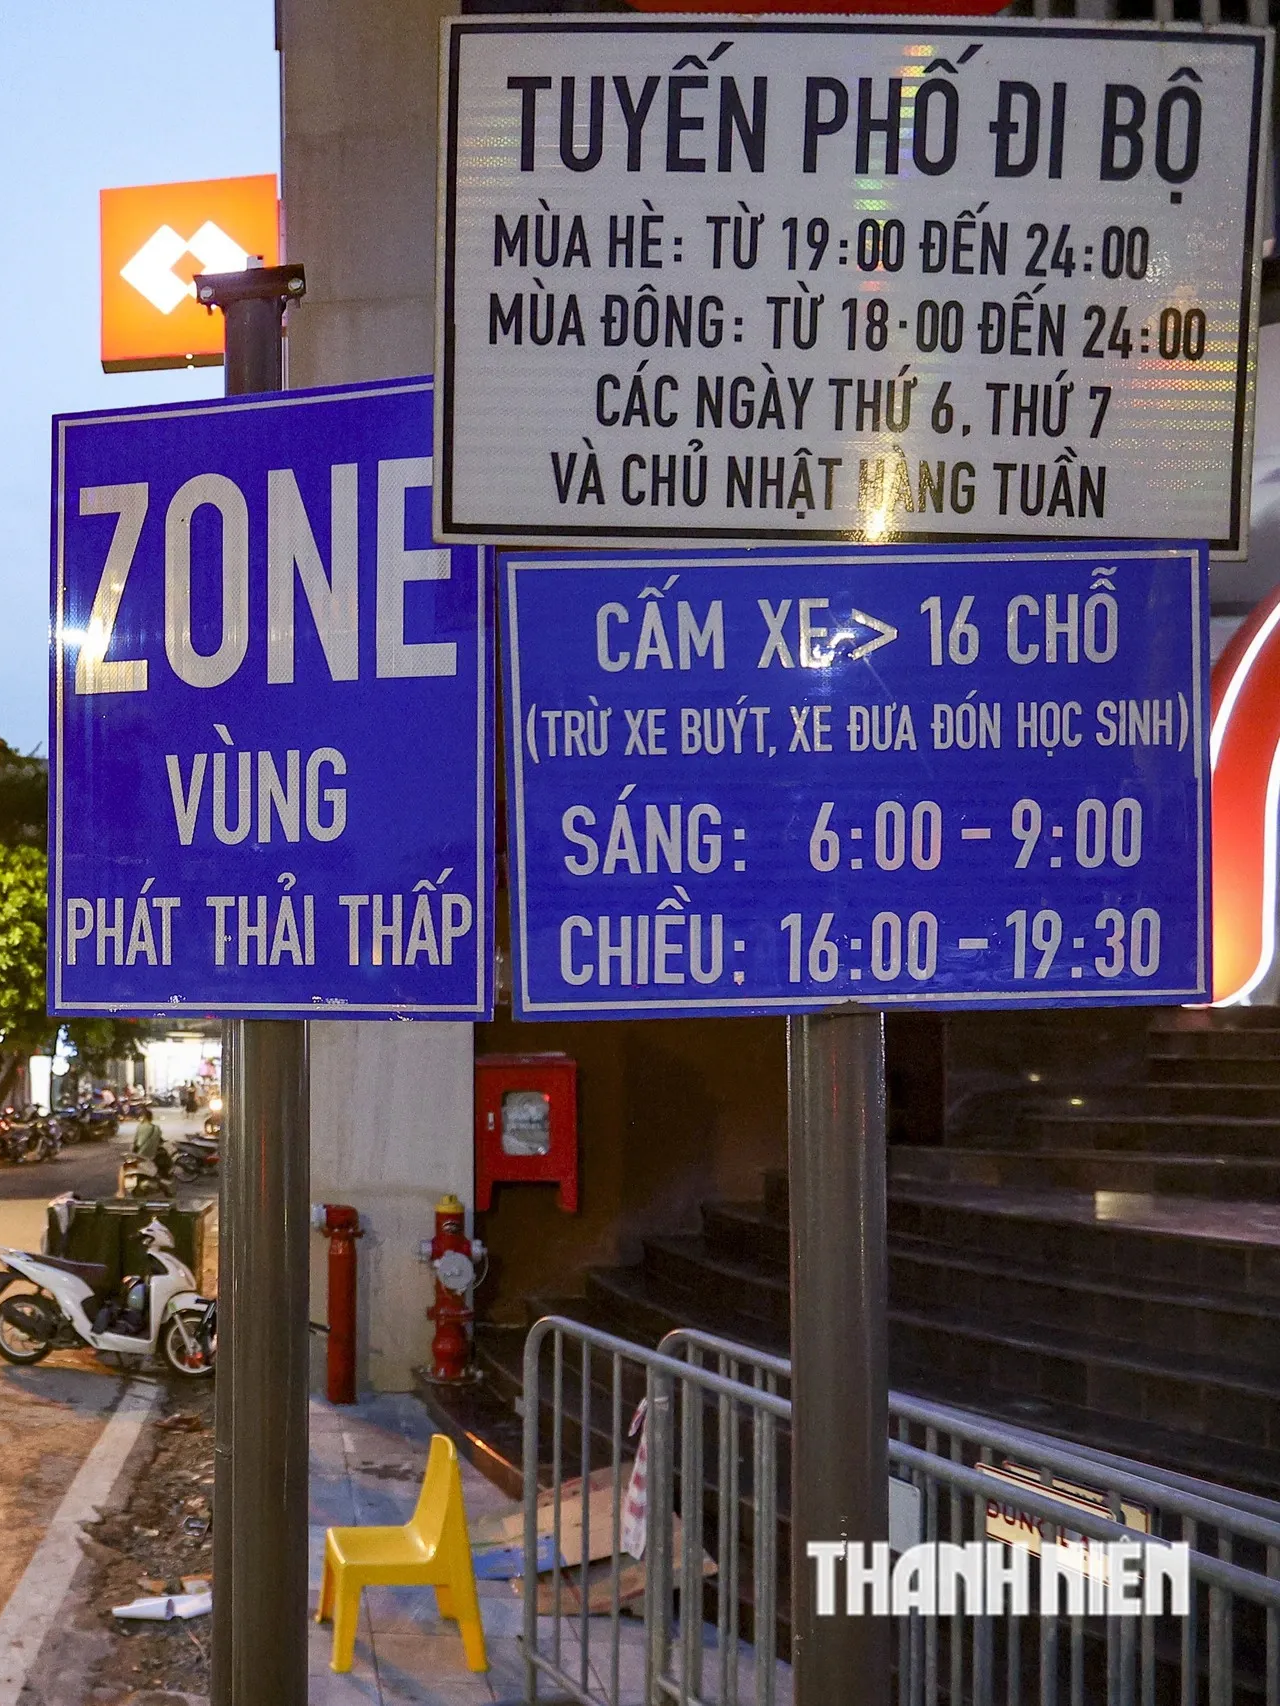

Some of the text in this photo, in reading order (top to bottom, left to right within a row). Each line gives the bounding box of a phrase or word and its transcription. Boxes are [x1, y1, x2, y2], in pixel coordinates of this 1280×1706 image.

[507, 42, 1204, 204] TUYẾN PHỐ ĐI BỘ
[494, 196, 1150, 280] MÙA HÈ: TỪ 19:00 ĐẾN 24:00
[489, 277, 585, 347] MÙA
[601, 284, 744, 349] ĐÔNG:
[767, 281, 825, 351] TỪ
[979, 282, 1065, 357] ĐẾN
[1083, 304, 1206, 362] 24:00
[597, 360, 679, 428] CÁC
[698, 363, 814, 431] NGÀY
[829, 365, 918, 434] THỨ
[987, 370, 1073, 438] THỨ
[1089, 384, 1112, 440] 7
[551, 437, 1106, 519] VÀ CHỦ NHẬT HÀNG TUẦN
[75, 456, 457, 695] ZONE
[596, 574, 725, 672] CẤM
[757, 597, 832, 669] XE
[921, 596, 979, 666] 16
[1006, 567, 1119, 665] CHỖ
[527, 690, 1190, 764] (TRỪ XE BUÝT, XE ĐƯA ĐÓN HỌC SINH)
[166, 724, 347, 847] VÙNG
[562, 784, 746, 876] SÁNG:
[810, 800, 941, 872] 6:00
[1012, 797, 1142, 869] 9:00
[66, 868, 473, 967] PHÁT THẢI THẤP
[561, 886, 746, 986] CHIỀU:
[780, 911, 939, 983] 16:00
[1005, 908, 1160, 978] 19:30
